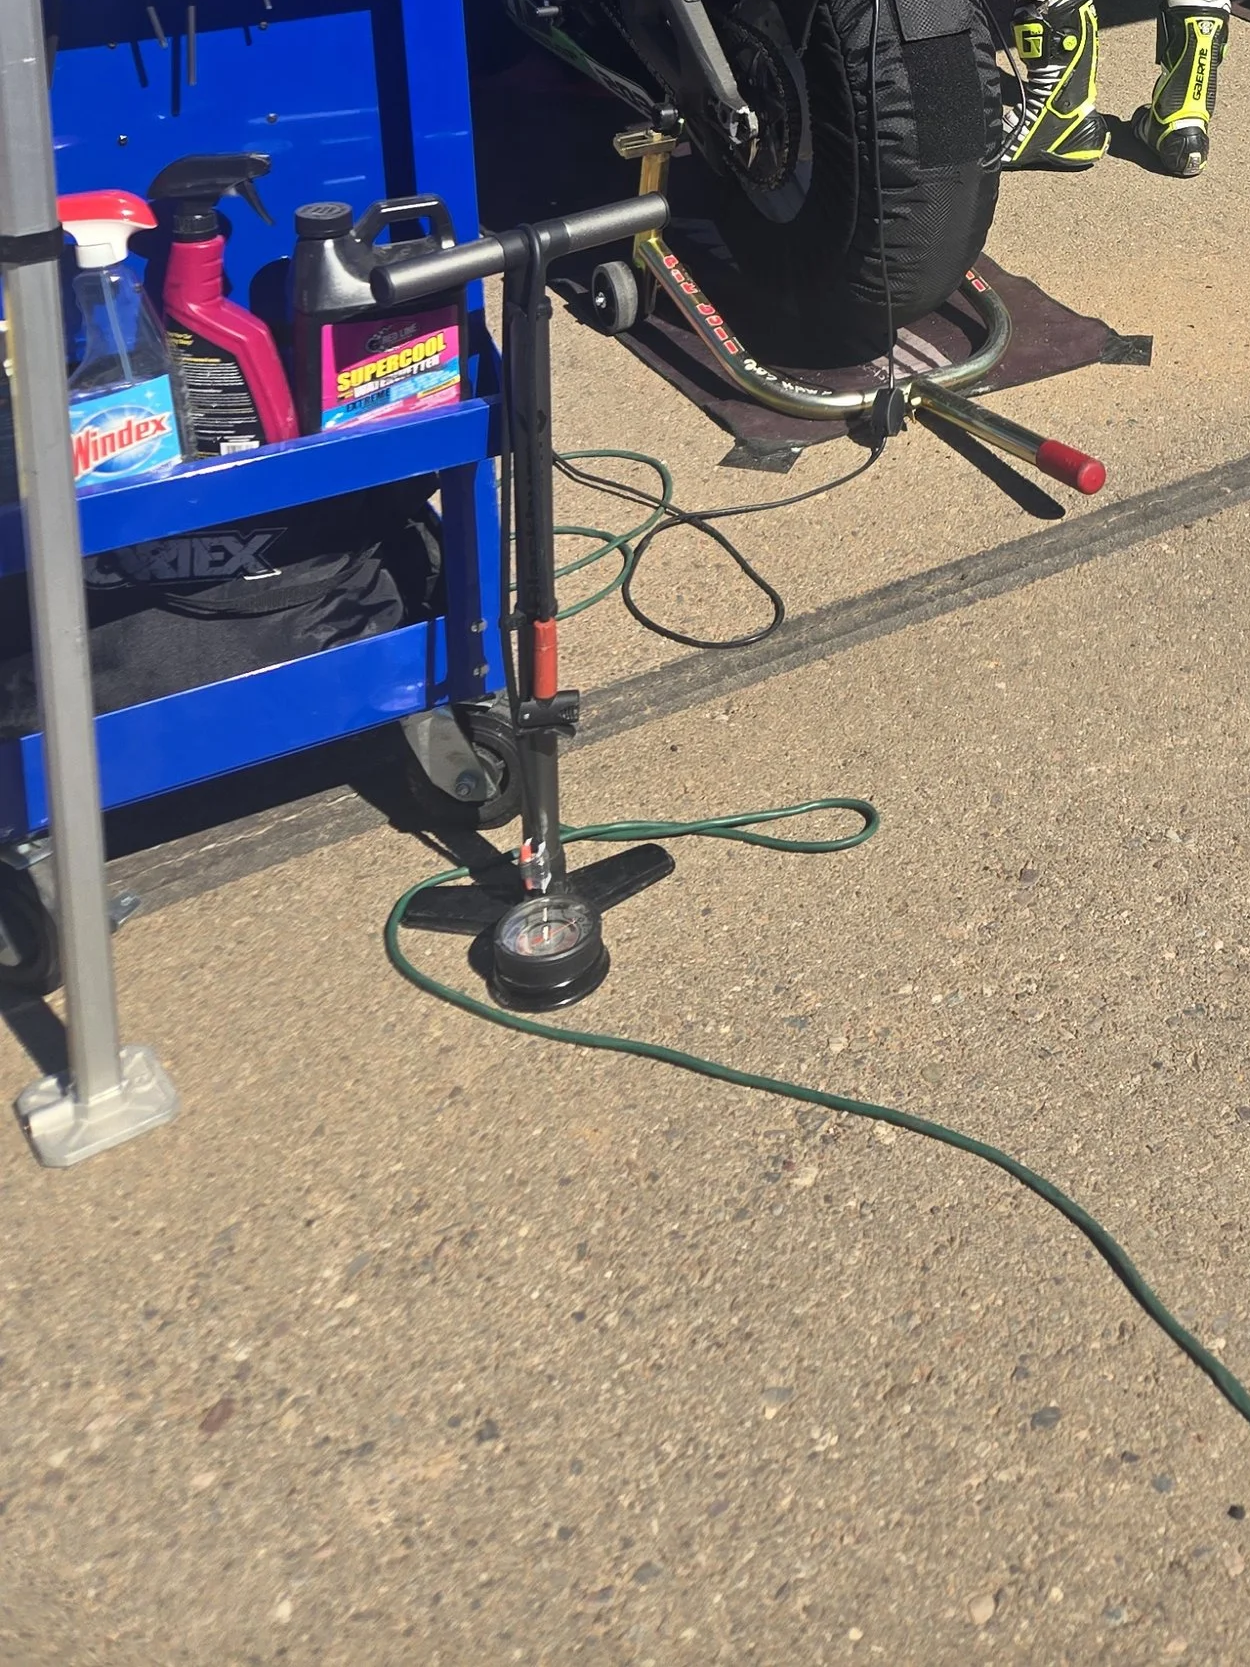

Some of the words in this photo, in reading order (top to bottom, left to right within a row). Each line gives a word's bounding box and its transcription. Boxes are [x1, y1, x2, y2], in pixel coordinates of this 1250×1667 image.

[337, 332, 447, 393] SUPERCOOL
[346, 387, 391, 413] EXTREME
[71, 415, 169, 478] Windex
